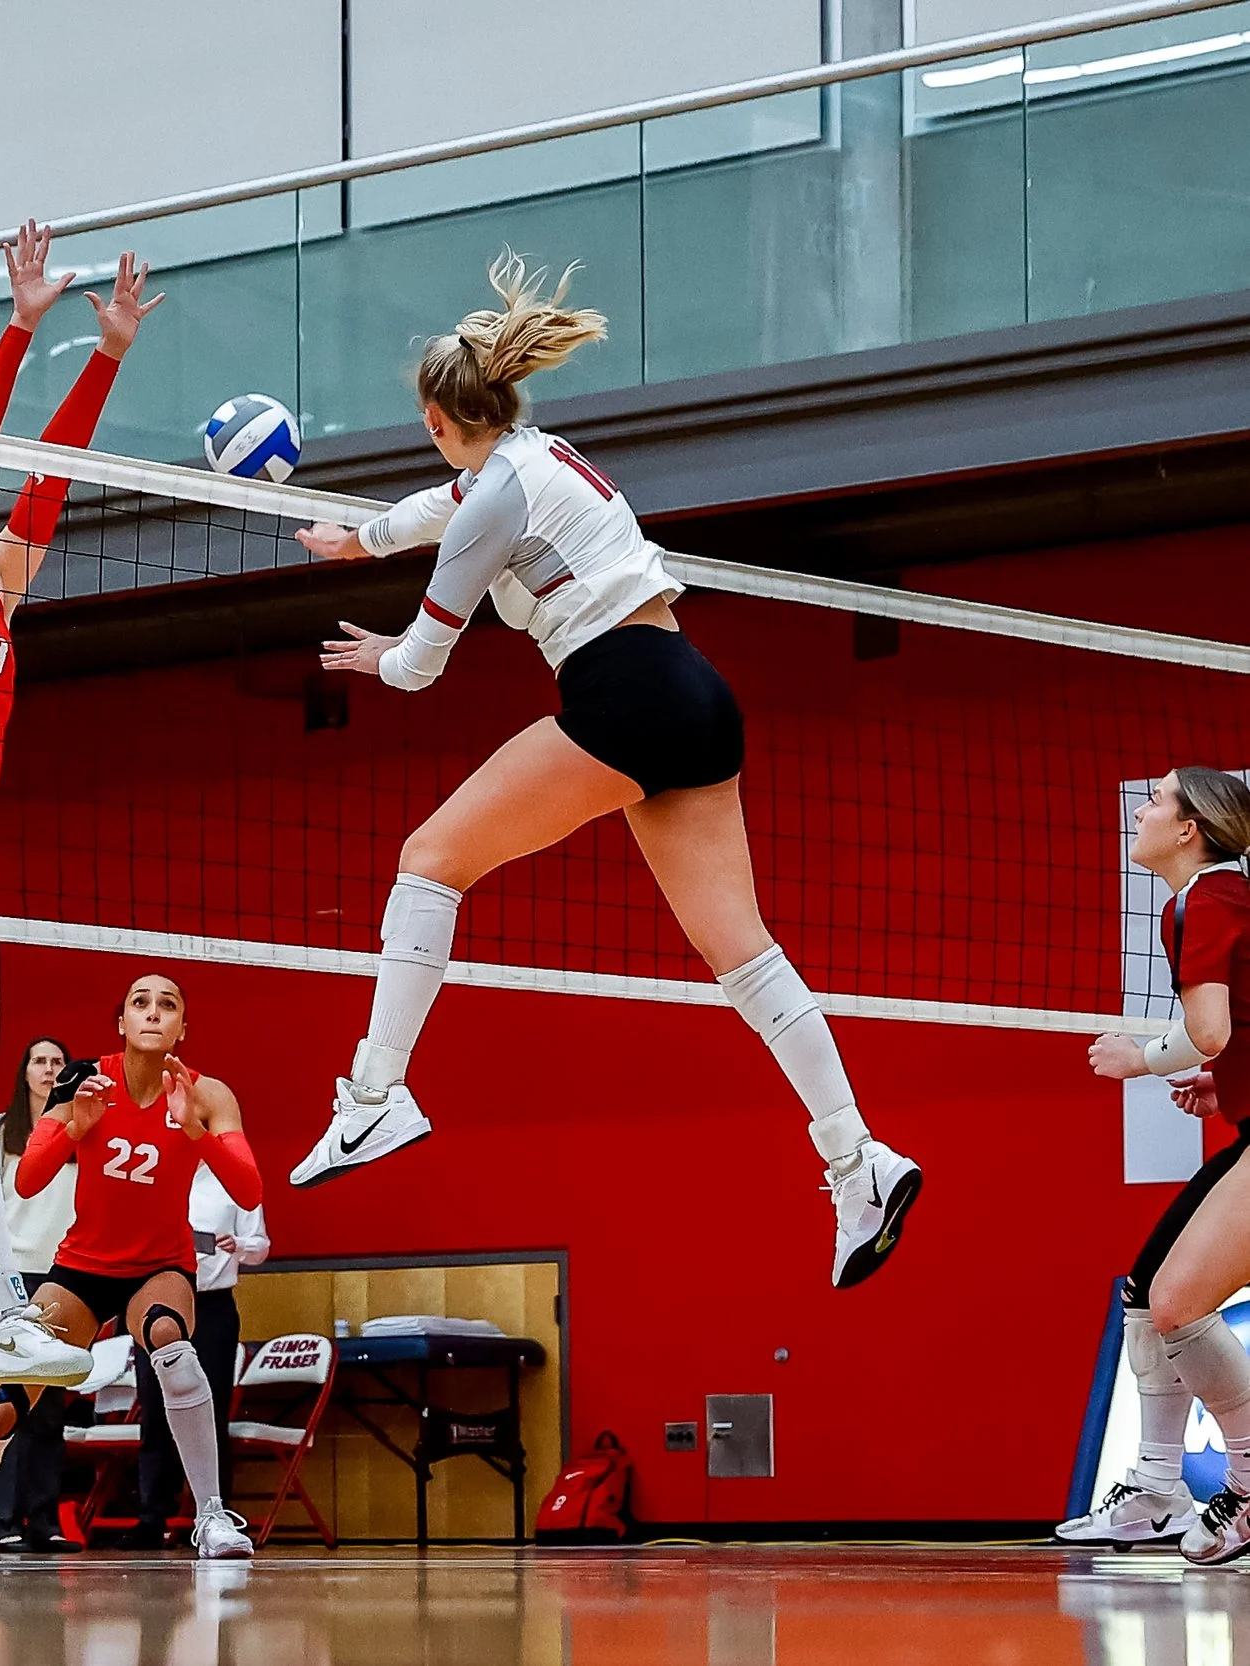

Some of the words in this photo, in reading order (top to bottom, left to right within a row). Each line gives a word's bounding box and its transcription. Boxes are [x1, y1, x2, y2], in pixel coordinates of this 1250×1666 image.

[103, 1137, 159, 1184] 22
[270, 1339, 322, 1353] SIMON
[259, 1353, 320, 1369] FRASER
